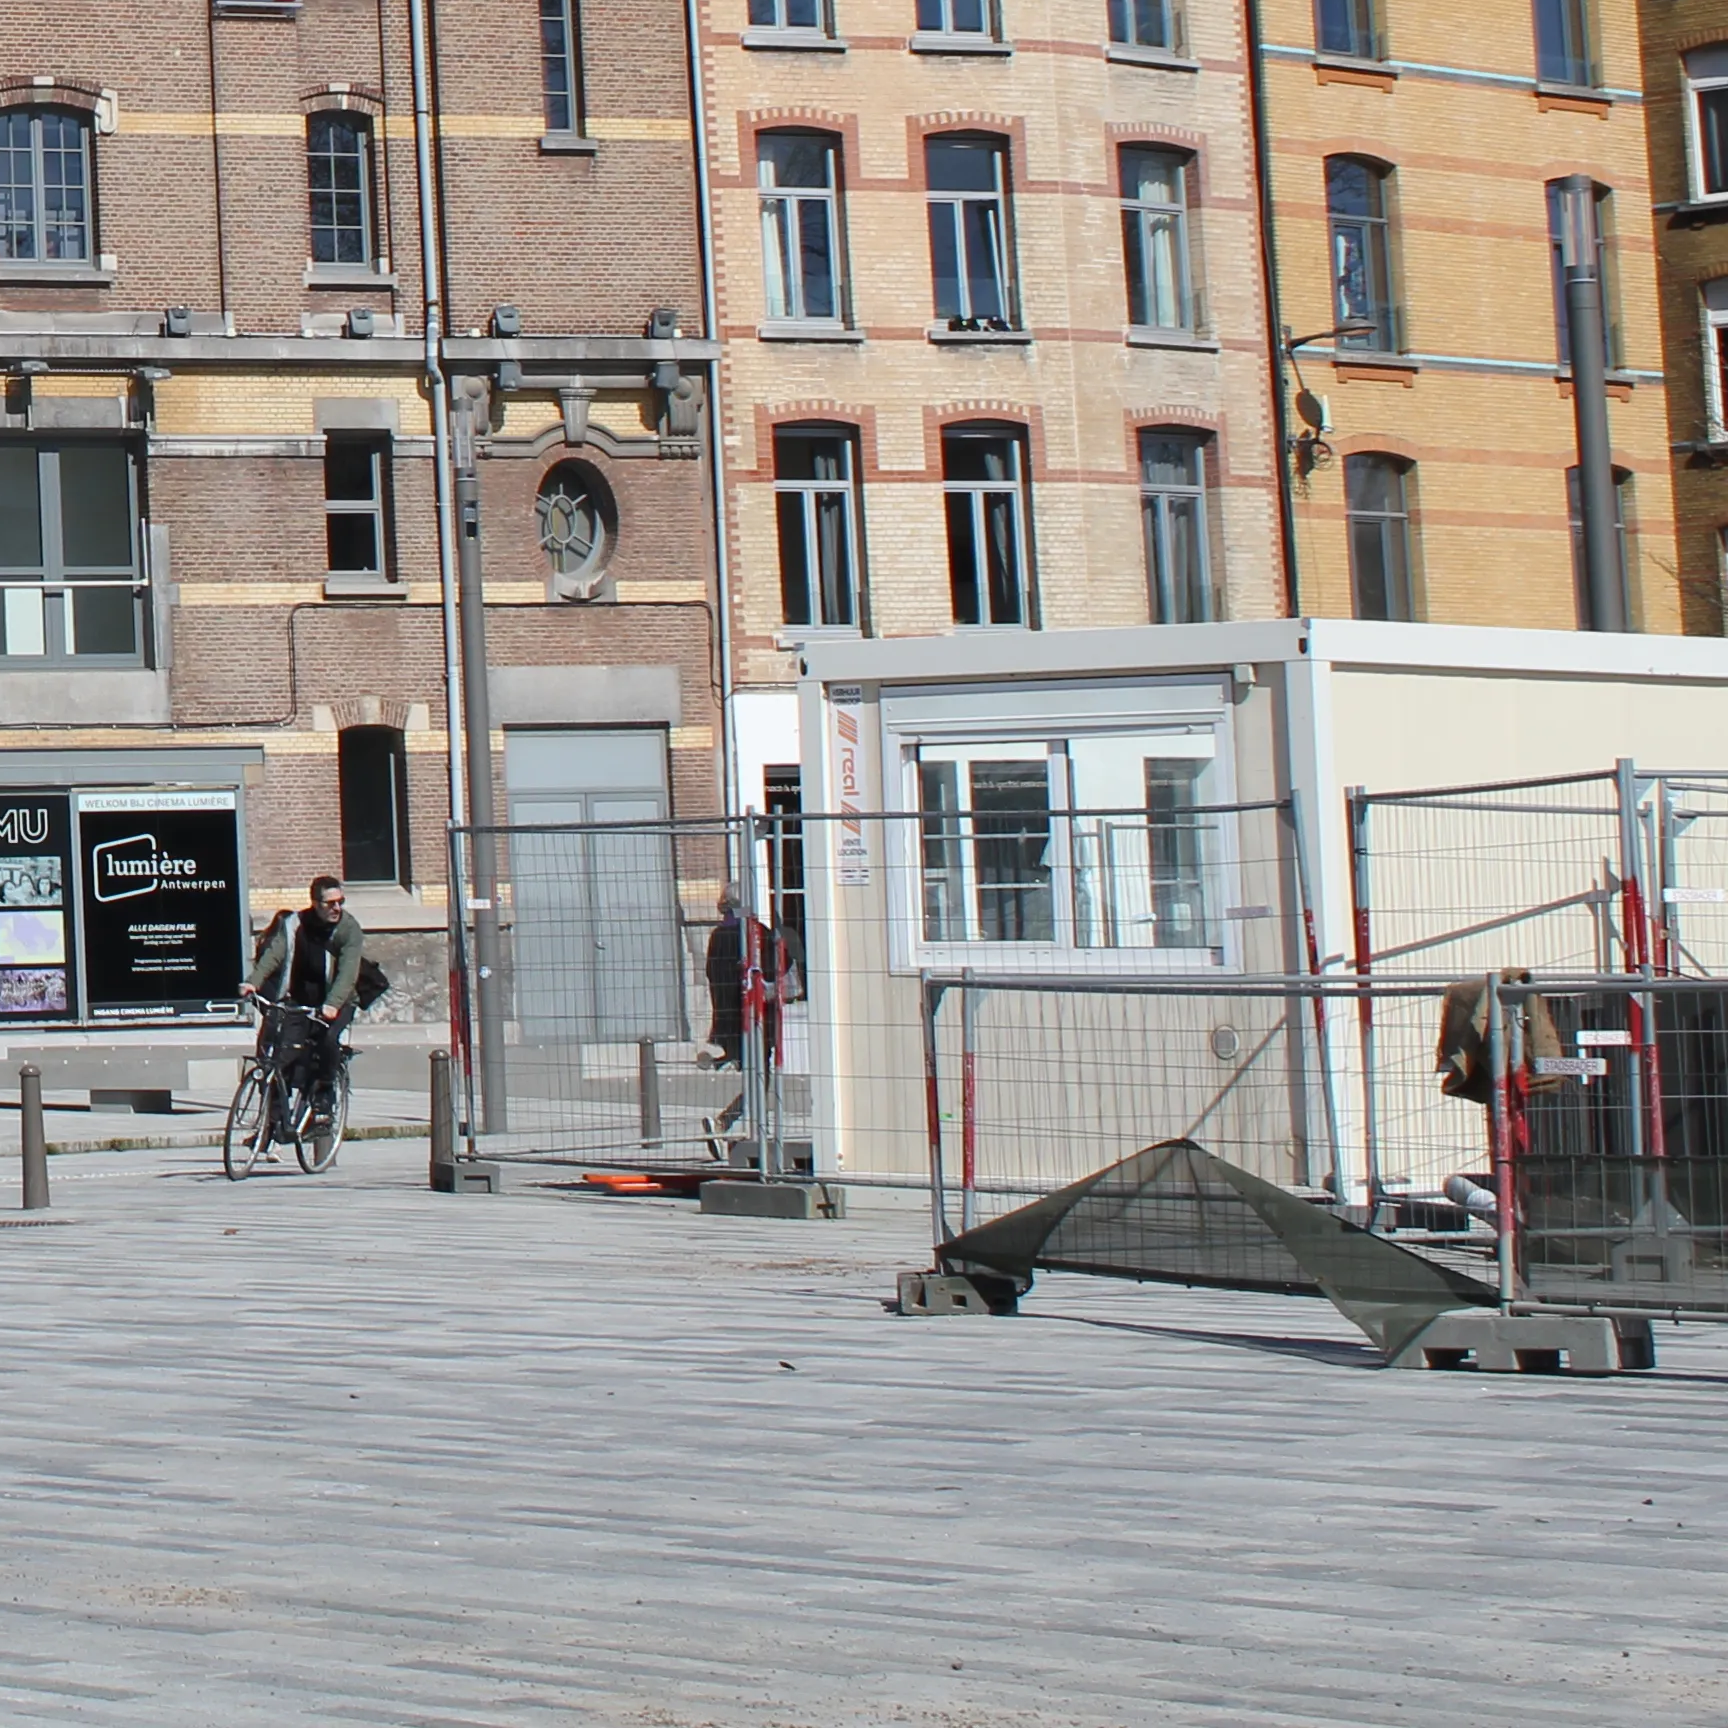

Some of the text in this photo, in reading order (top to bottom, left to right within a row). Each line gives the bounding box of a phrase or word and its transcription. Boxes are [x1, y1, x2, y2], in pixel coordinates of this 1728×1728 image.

[840, 747, 861, 797] real
[84, 795, 230, 809] WELKOM BIJ CINEMA LUMIÈRE
[105, 851, 197, 877] lumière
[160, 878, 227, 891] Antwerpen
[127, 924, 148, 932] ALLE
[1543, 1058, 1599, 1072] STADSBADER
